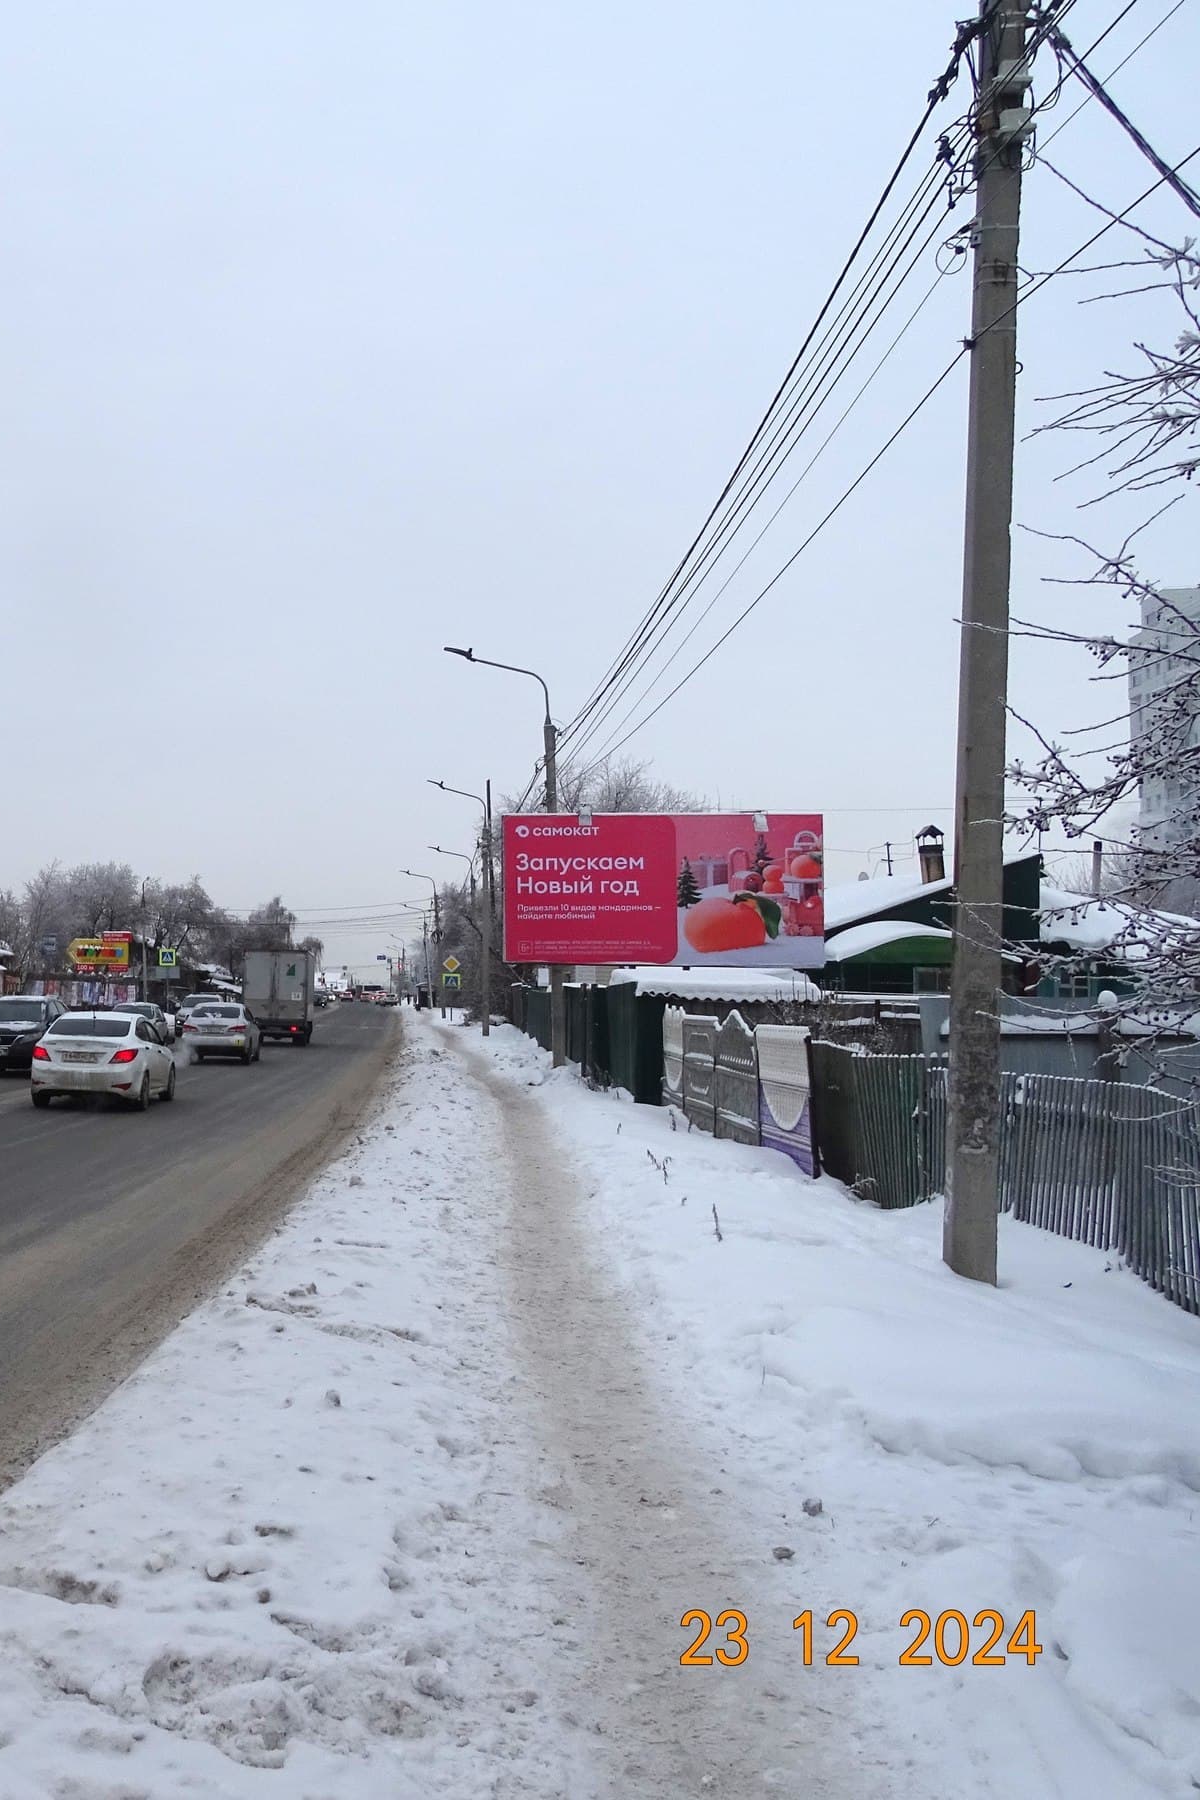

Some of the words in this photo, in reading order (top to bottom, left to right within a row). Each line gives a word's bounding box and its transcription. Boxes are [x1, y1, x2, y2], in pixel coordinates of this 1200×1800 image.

[533, 826, 600, 836] самокат
[515, 853, 644, 875] Запускаем
[517, 875, 593, 894] Новый
[600, 880, 640, 896] год
[517, 904, 559, 912] Привезли
[571, 904, 597, 912] видов
[517, 912, 552, 921] найдите
[554, 912, 596, 920] любимый
